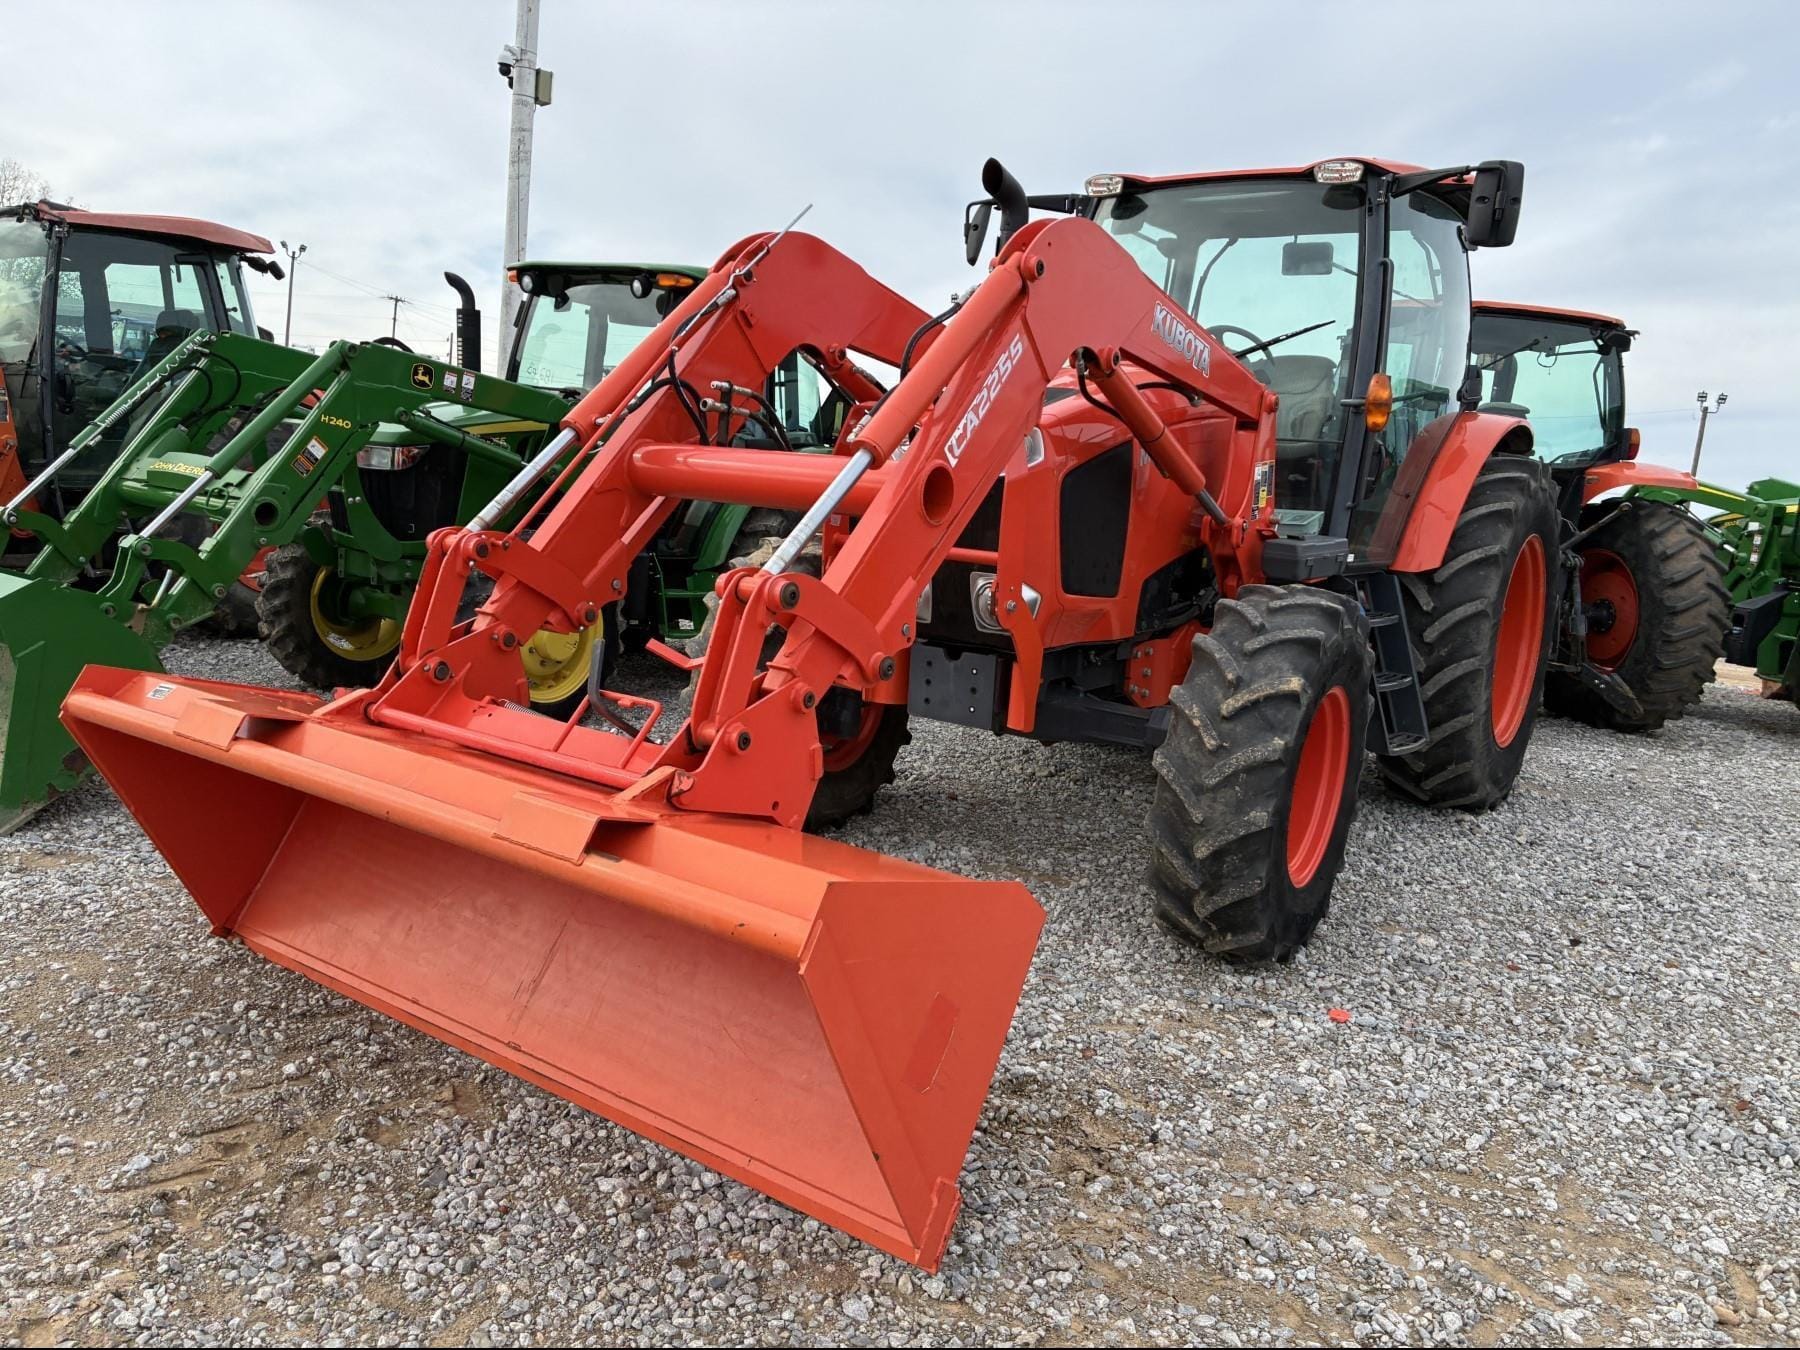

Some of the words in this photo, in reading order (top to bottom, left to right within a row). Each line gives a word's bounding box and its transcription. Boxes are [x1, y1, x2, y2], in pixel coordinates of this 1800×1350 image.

[1152, 302, 1210, 377] KUBOTA
[321, 414, 352, 429] H240
[150, 461, 175, 471] JOHN
